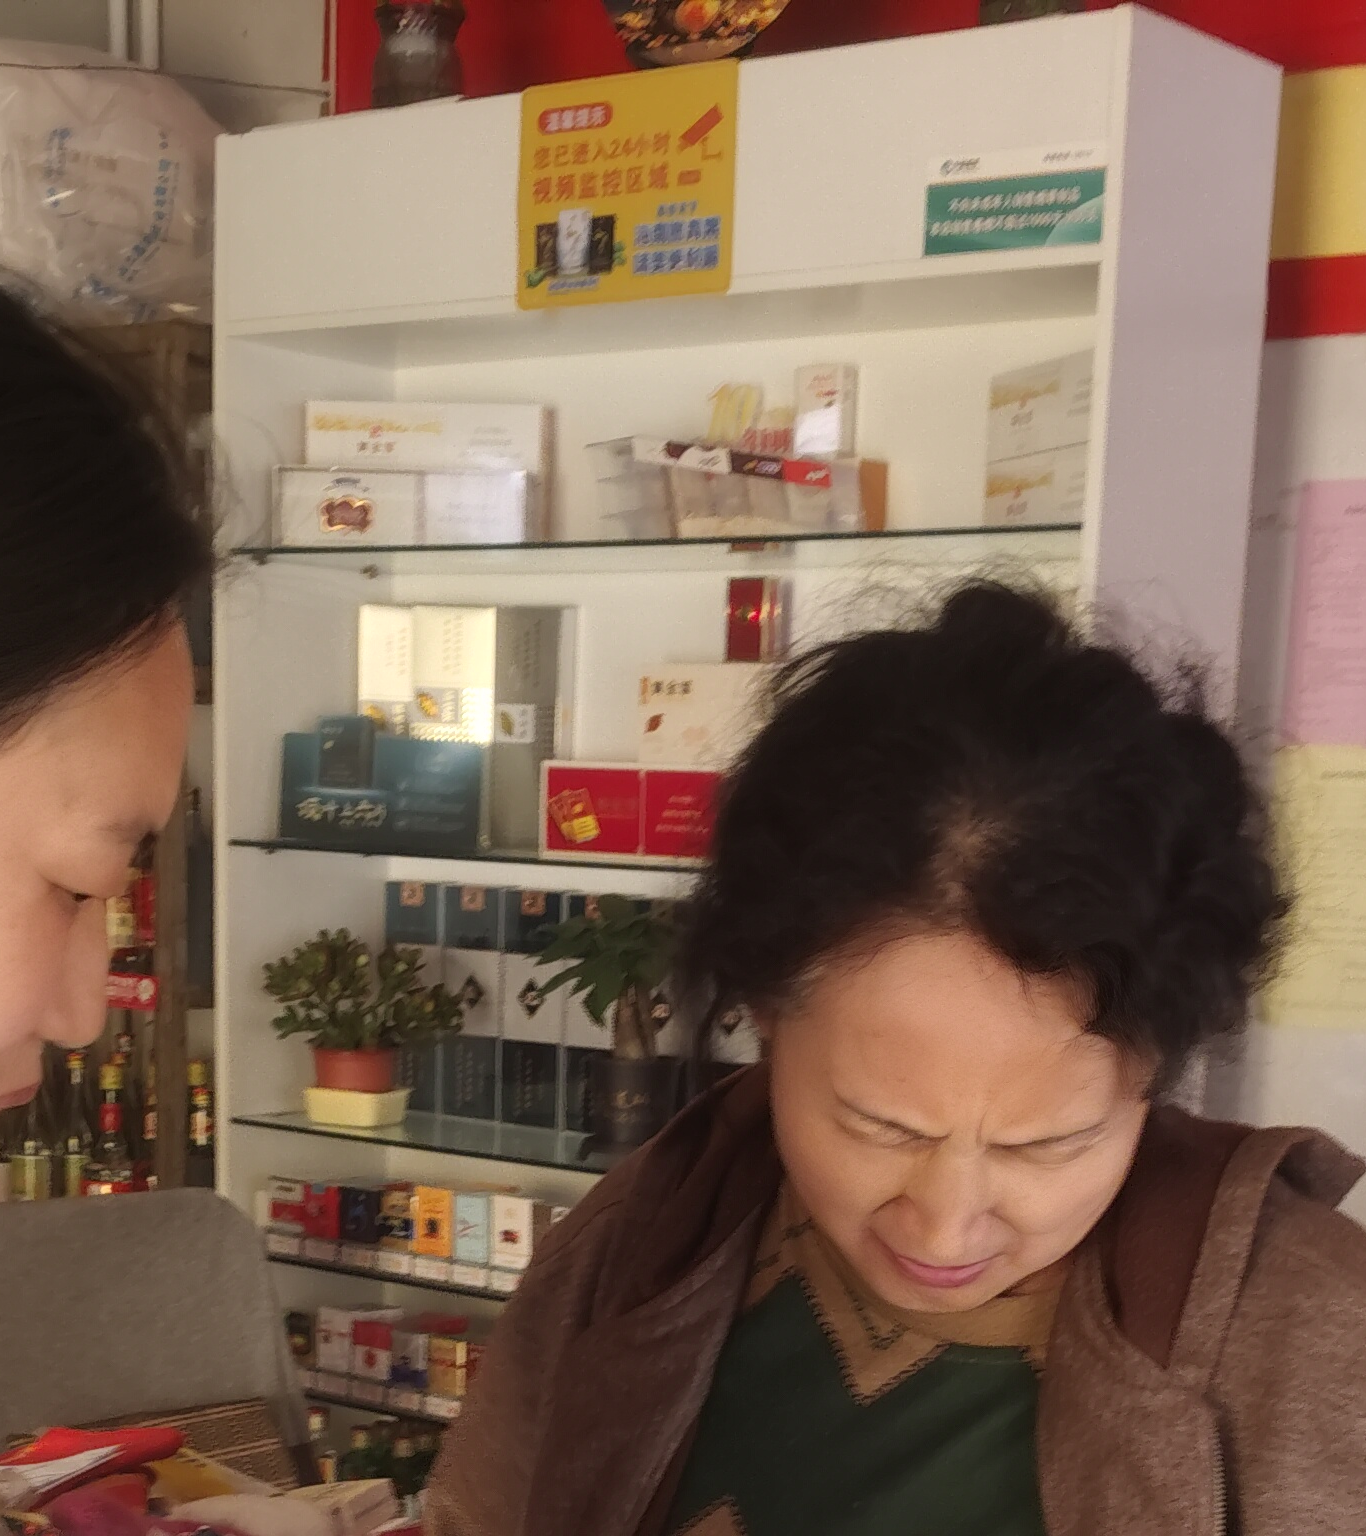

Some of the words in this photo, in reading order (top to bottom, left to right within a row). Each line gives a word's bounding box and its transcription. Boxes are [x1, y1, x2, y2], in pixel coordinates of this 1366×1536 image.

[533, 160, 670, 205] 视频监控区域
